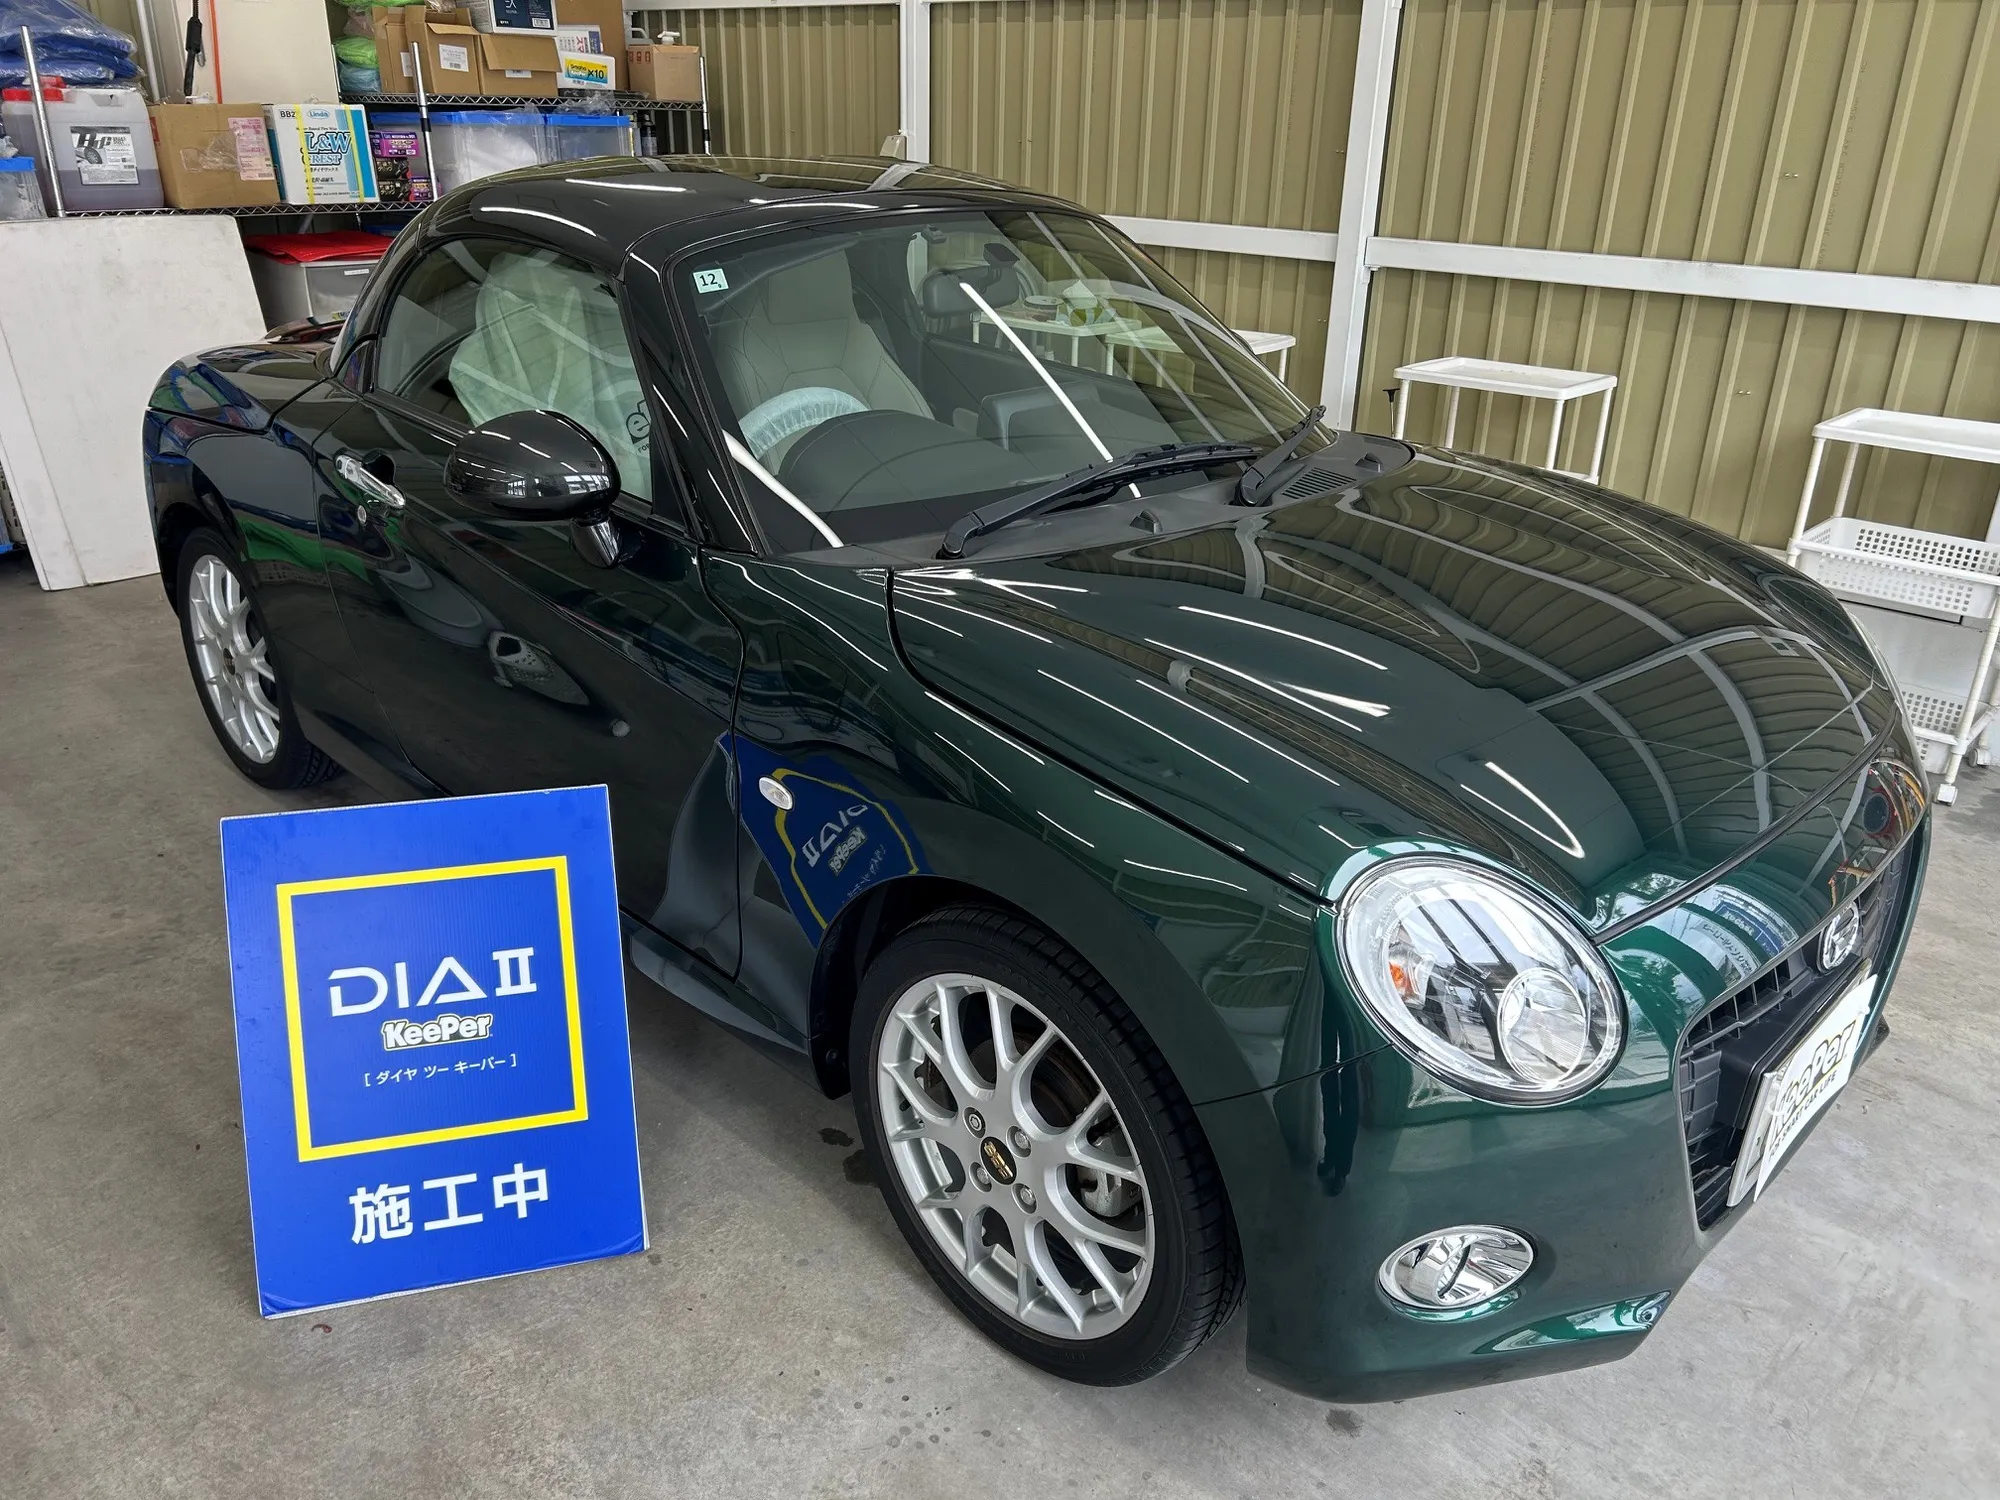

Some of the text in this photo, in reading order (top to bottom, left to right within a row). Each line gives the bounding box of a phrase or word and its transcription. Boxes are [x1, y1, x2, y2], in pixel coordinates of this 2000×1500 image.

[302, 153, 342, 166] REST
[699, 273, 718, 287] 12
[381, 1012, 494, 1052] KeePer
[376, 1067, 418, 1085] ダイヤ
[423, 1065, 449, 1079] ツー
[454, 1056, 506, 1074] キーパー
[1819, 1069, 1838, 1094] LIFE
[349, 1163, 549, 1245] 施工中
